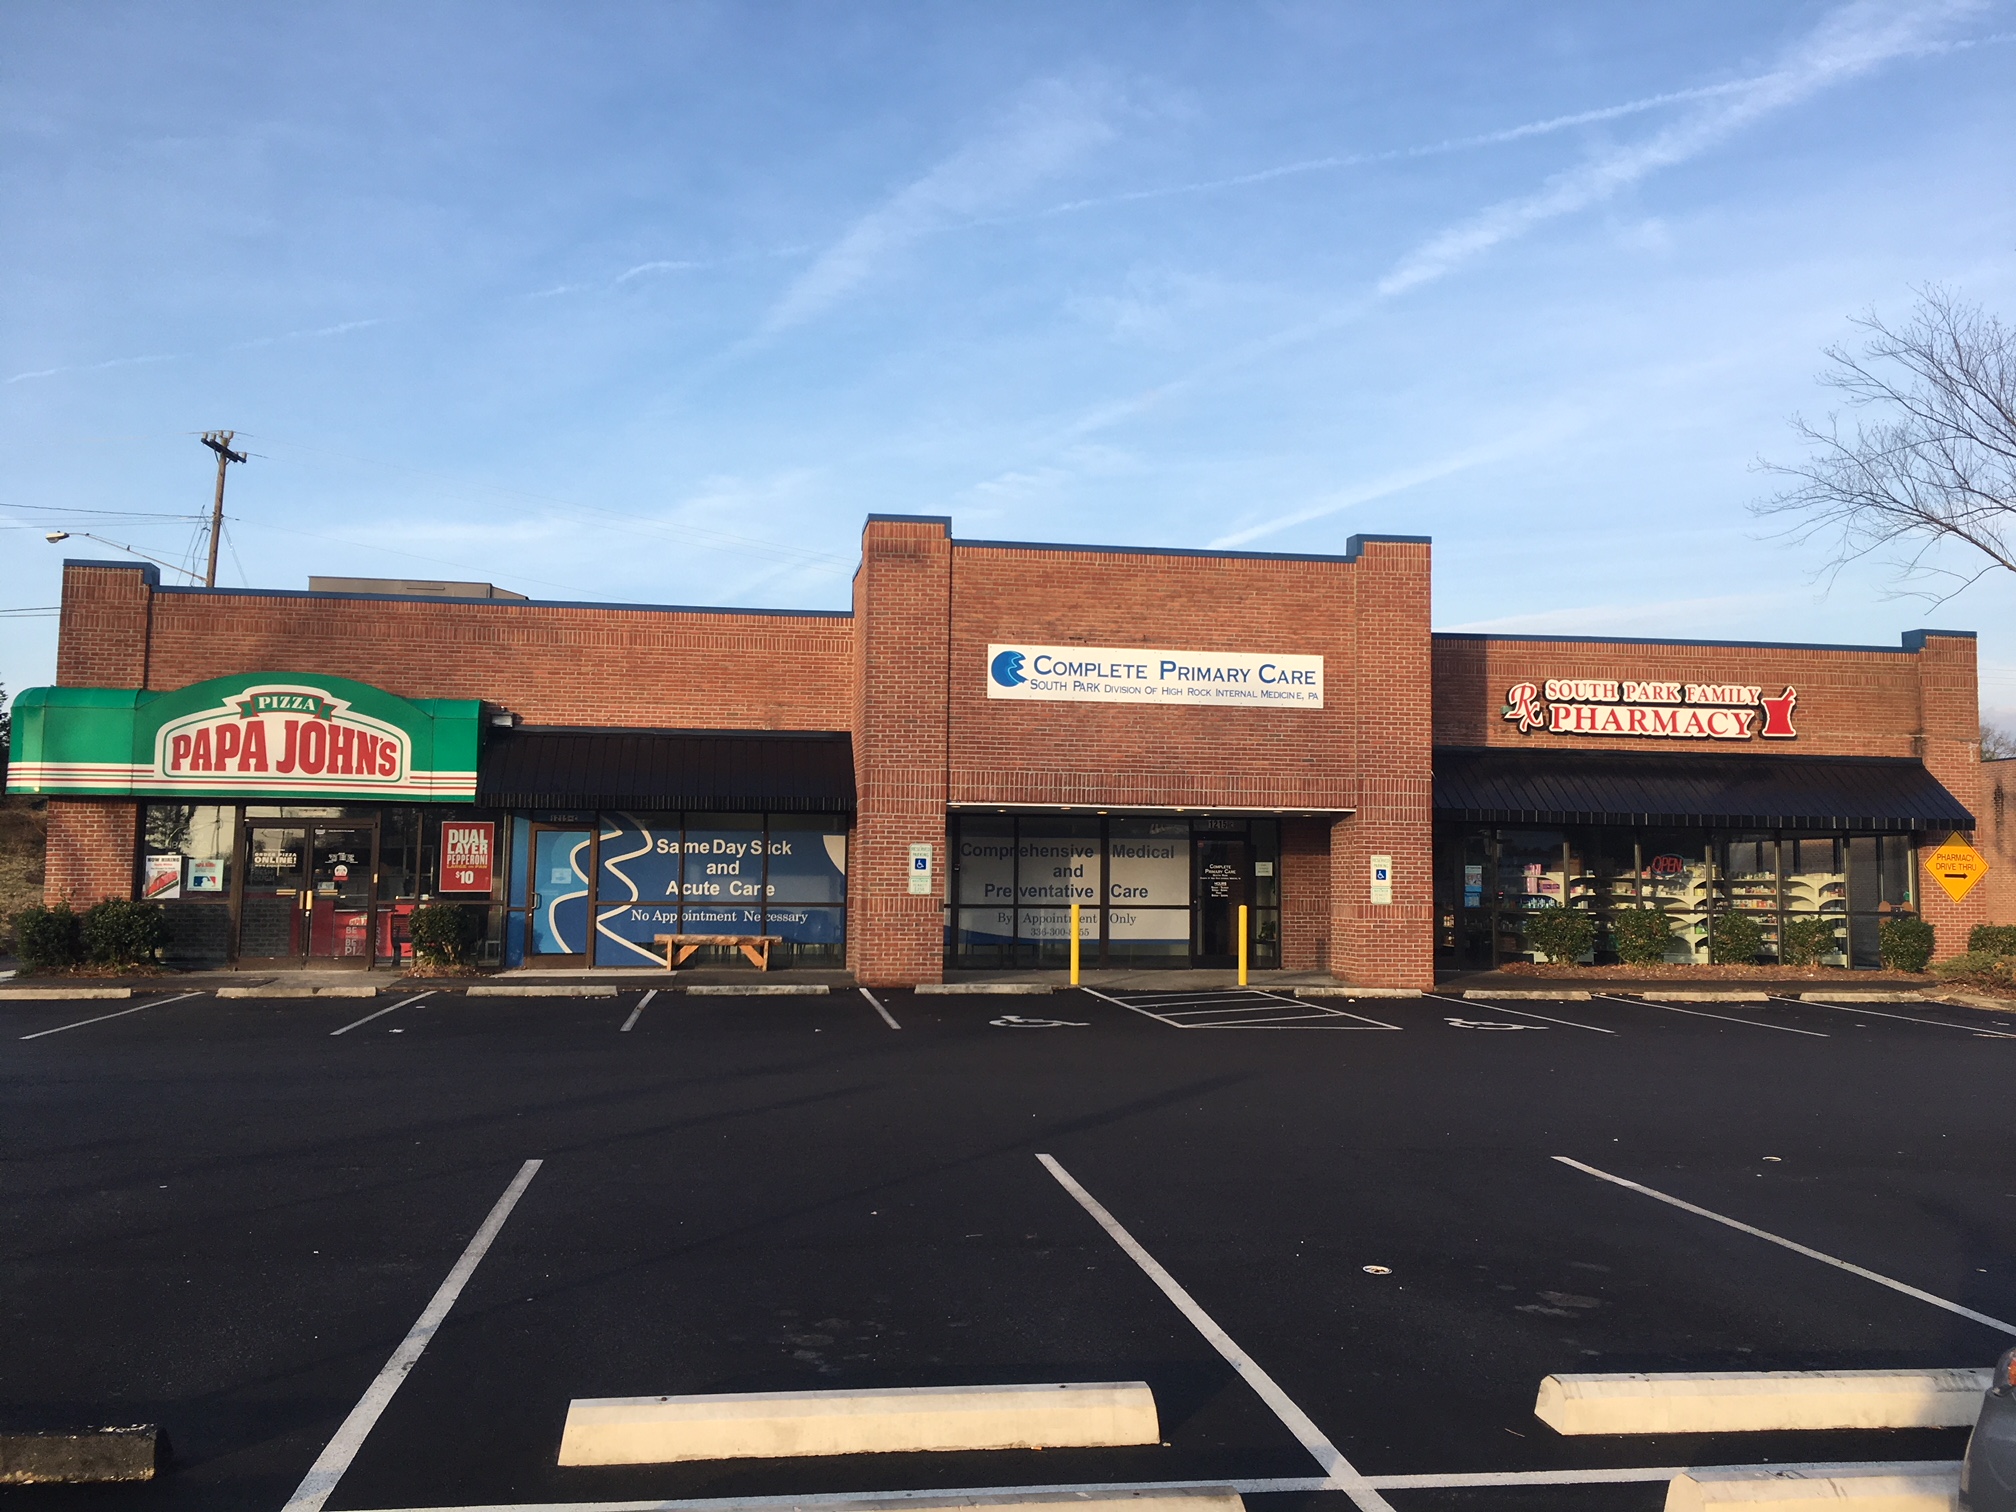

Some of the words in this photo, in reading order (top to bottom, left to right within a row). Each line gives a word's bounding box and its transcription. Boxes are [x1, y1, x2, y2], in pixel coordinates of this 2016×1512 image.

[1034, 655, 1148, 679] COMPLETE
[1159, 660, 1251, 683] PRIMARY
[1258, 663, 1316, 685] CARE
[1030, 678, 1067, 691] SOUTH
[1073, 680, 1100, 693] PARK
[1104, 684, 1141, 694] DIVISION
[1145, 686, 1157, 695] OF
[1161, 687, 1183, 695] HIGH
[1187, 687, 1212, 697] ROCK
[1216, 688, 1257, 698] INTERNAL
[1308, 692, 1319, 700] PA
[1548, 683, 1616, 699] SOUTH
[1626, 684, 1680, 700] PARK
[1686, 686, 1760, 703] FAMILY
[258, 696, 315, 711] PIZZA
[1551, 706, 1752, 736] PHARMACY
[171, 720, 269, 772] PAPA
[276, 720, 397, 776] JOHN'S
[448, 829, 488, 844] DUAL
[448, 843, 488, 854] LAYER
[656, 839, 710, 854] Same
[713, 839, 747, 858] Day
[750, 840, 792, 855] Sick
[960, 842, 1094, 861] Comprehensive
[1113, 844, 1174, 859] Medical
[254, 856, 297, 864] ONLINE!
[446, 854, 488, 865] PEPPERONI
[1652, 855, 1683, 872] OPEN
[1936, 853, 1976, 862] PHARMACY
[706, 861, 740, 875] and
[1053, 864, 1084, 878] and
[1935, 862, 1957, 870] DRIVE
[1958, 863, 1977, 871] THRU
[455, 870, 474, 885] $10
[665, 881, 720, 896] Acute
[729, 881, 776, 896] Care
[984, 883, 1094, 898] Preventative
[1110, 884, 1149, 898] Care
[631, 909, 650, 921] No
[652, 910, 737, 924] Appointment
[744, 910, 808, 924] Necessary
[997, 912, 1012, 925] By
[1109, 913, 1137, 926] Only
